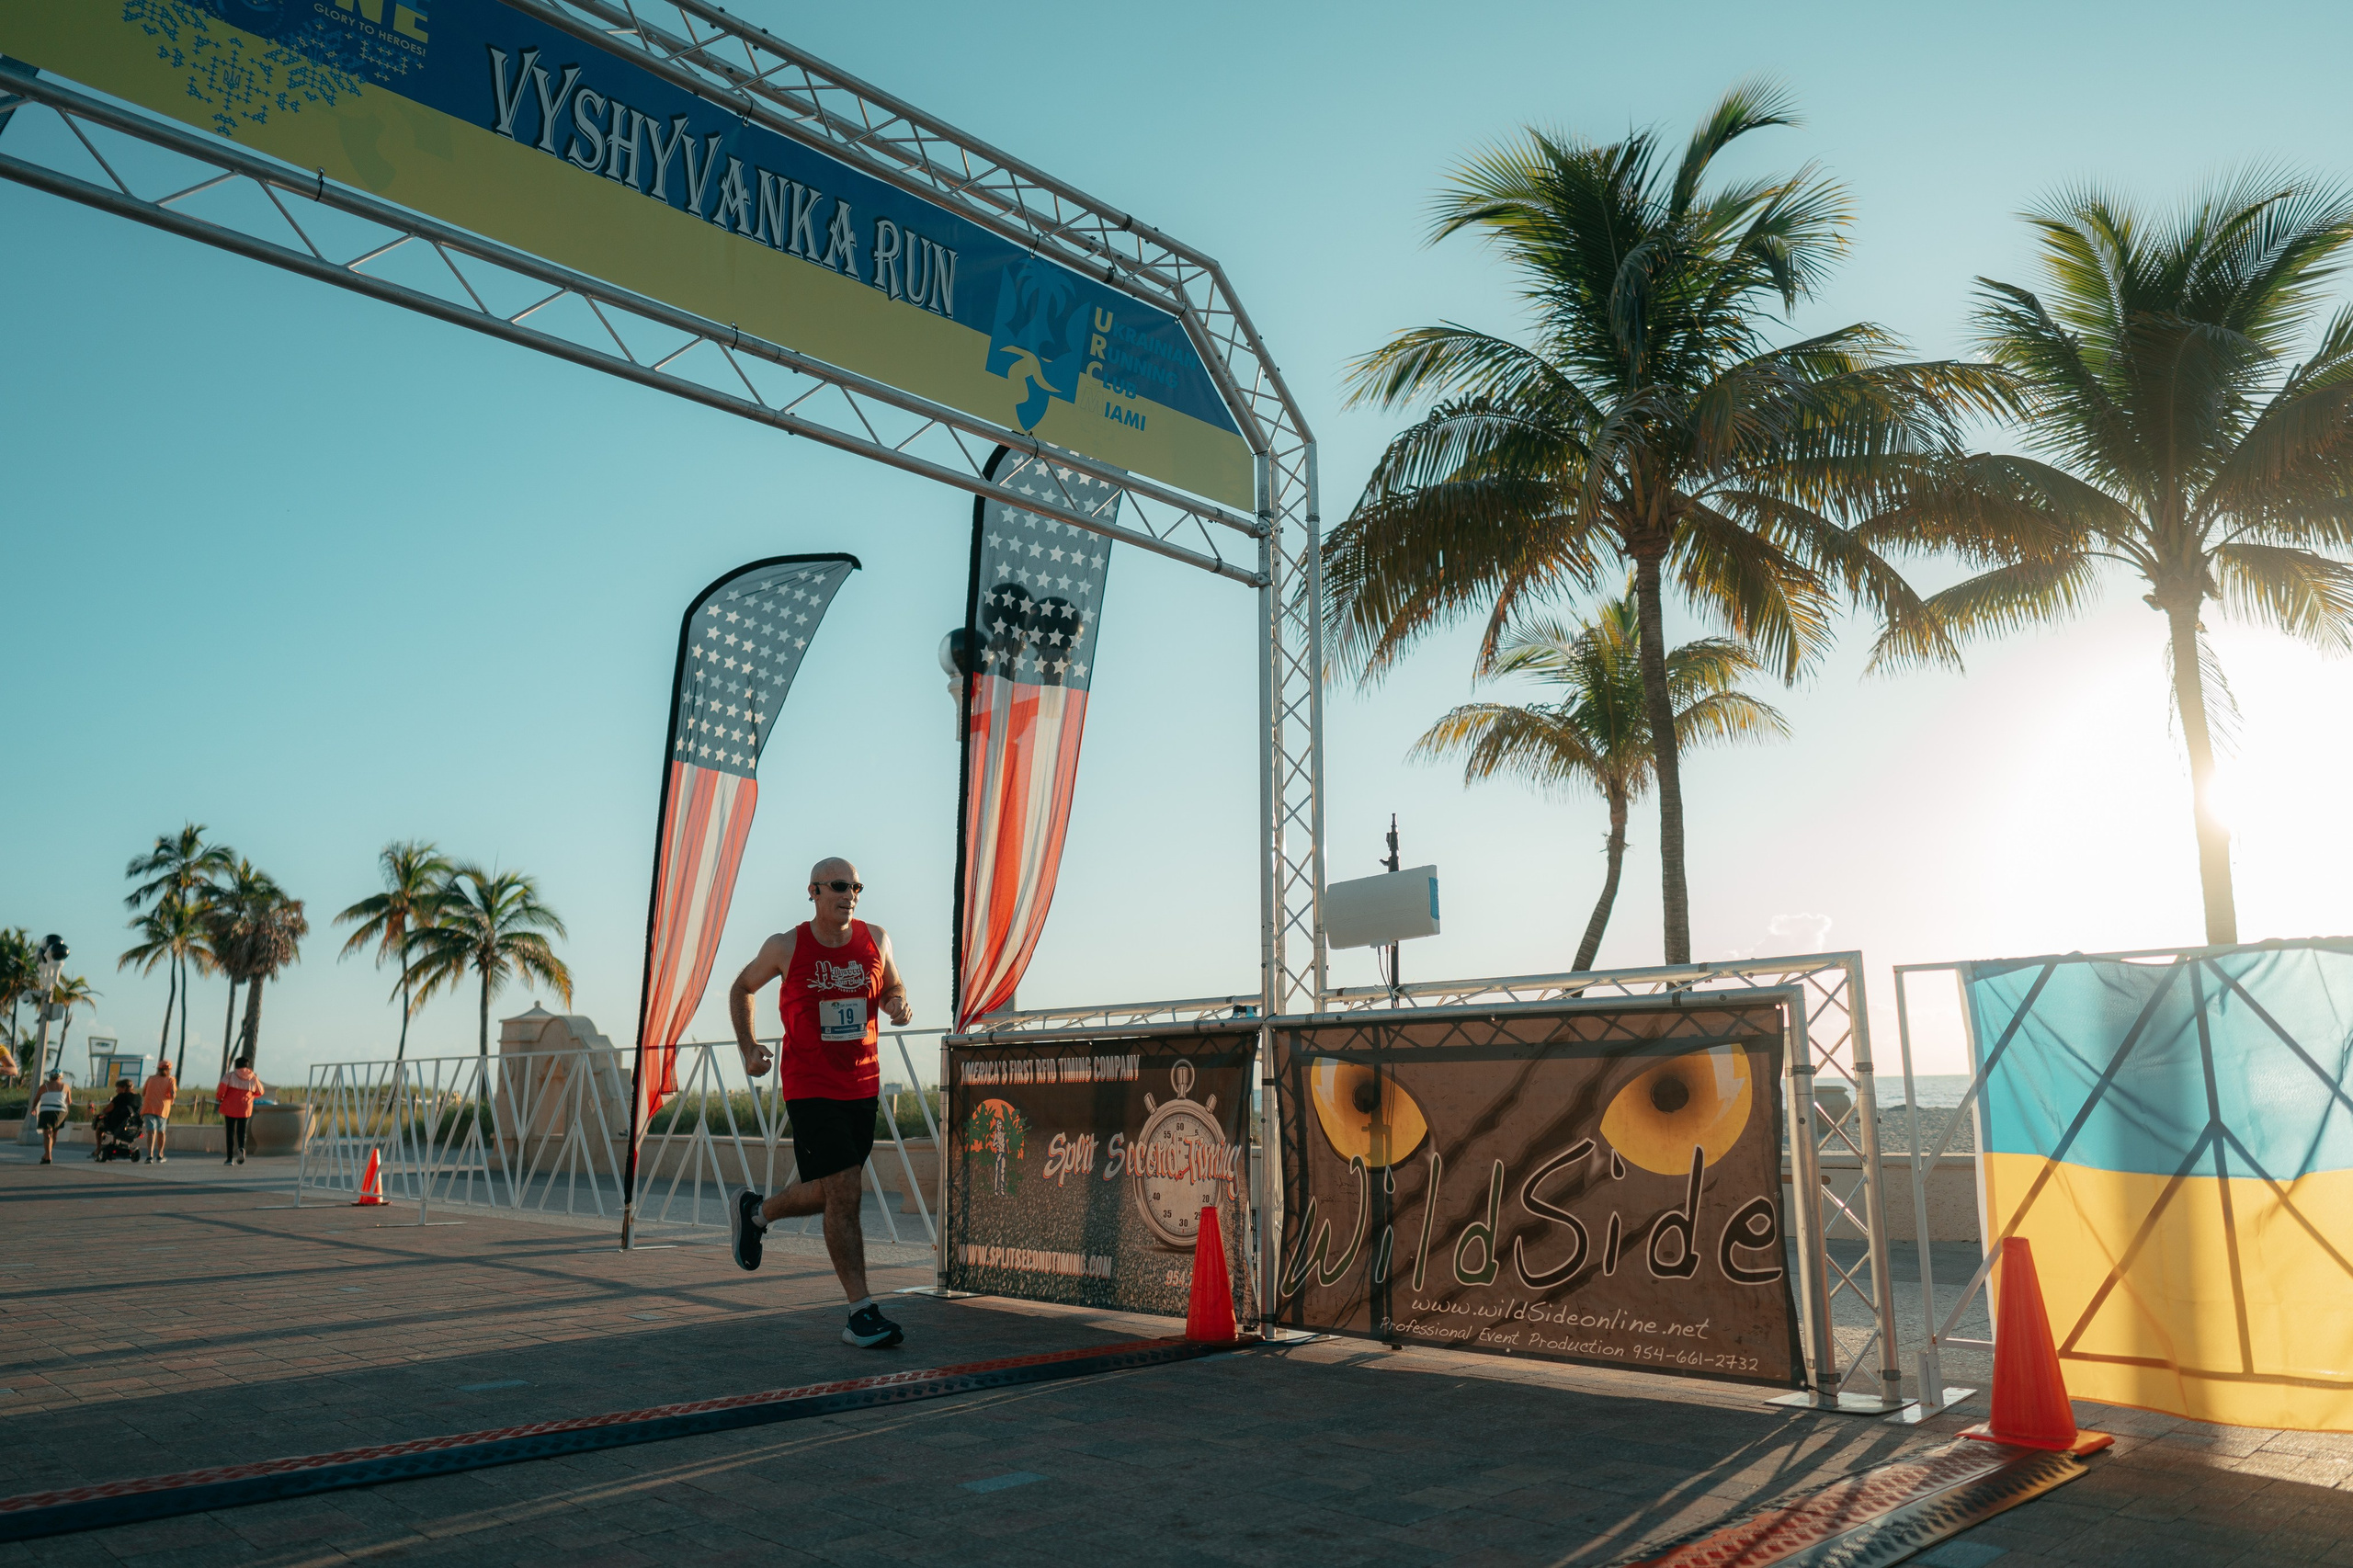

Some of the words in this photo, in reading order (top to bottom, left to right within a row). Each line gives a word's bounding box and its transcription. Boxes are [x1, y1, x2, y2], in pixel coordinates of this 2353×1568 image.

[313, 3, 356, 27] GLORY
[359, 21, 374, 35] TO
[379, 30, 426, 57] HEROES!
[487, 44, 860, 281] VYSHYVANKA
[873, 219, 959, 319] RUN
[1094, 306, 1198, 371] UKRAINIAN
[1086, 360, 1138, 400] CLUB
[1089, 333, 1178, 390] RUNNING
[838, 1008, 854, 1025] 19
[961, 1061, 1008, 1085] AMERICA'S
[1009, 1060, 1034, 1085] FIRST
[1036, 1059, 1057, 1084] RFID
[1058, 1057, 1092, 1083] TIMING
[1093, 1054, 1140, 1082] COMPANY
[1164, 1131, 1172, 1139] 55
[1176, 1122, 1184, 1131] 60
[1042, 1131, 1099, 1187] Split
[1103, 1131, 1178, 1181] Second
[1184, 1134, 1242, 1200] Timing
[1153, 1192, 1160, 1201] 40
[1163, 1210, 1172, 1219] 35
[1202, 1194, 1210, 1203] 20
[1179, 1218, 1188, 1227] 30
[1279, 1139, 1784, 1298] WildSide
[958, 1244, 1112, 1279] WWW.SPLITSECONDTIMING.COM
[1412, 1299, 1710, 1340] www.wildSideonline.net
[1380, 1316, 1472, 1340] Professional
[1479, 1328, 1519, 1346] Event
[1529, 1333, 1624, 1358] Production
[1632, 1345, 1758, 1372] 954-661-2732
